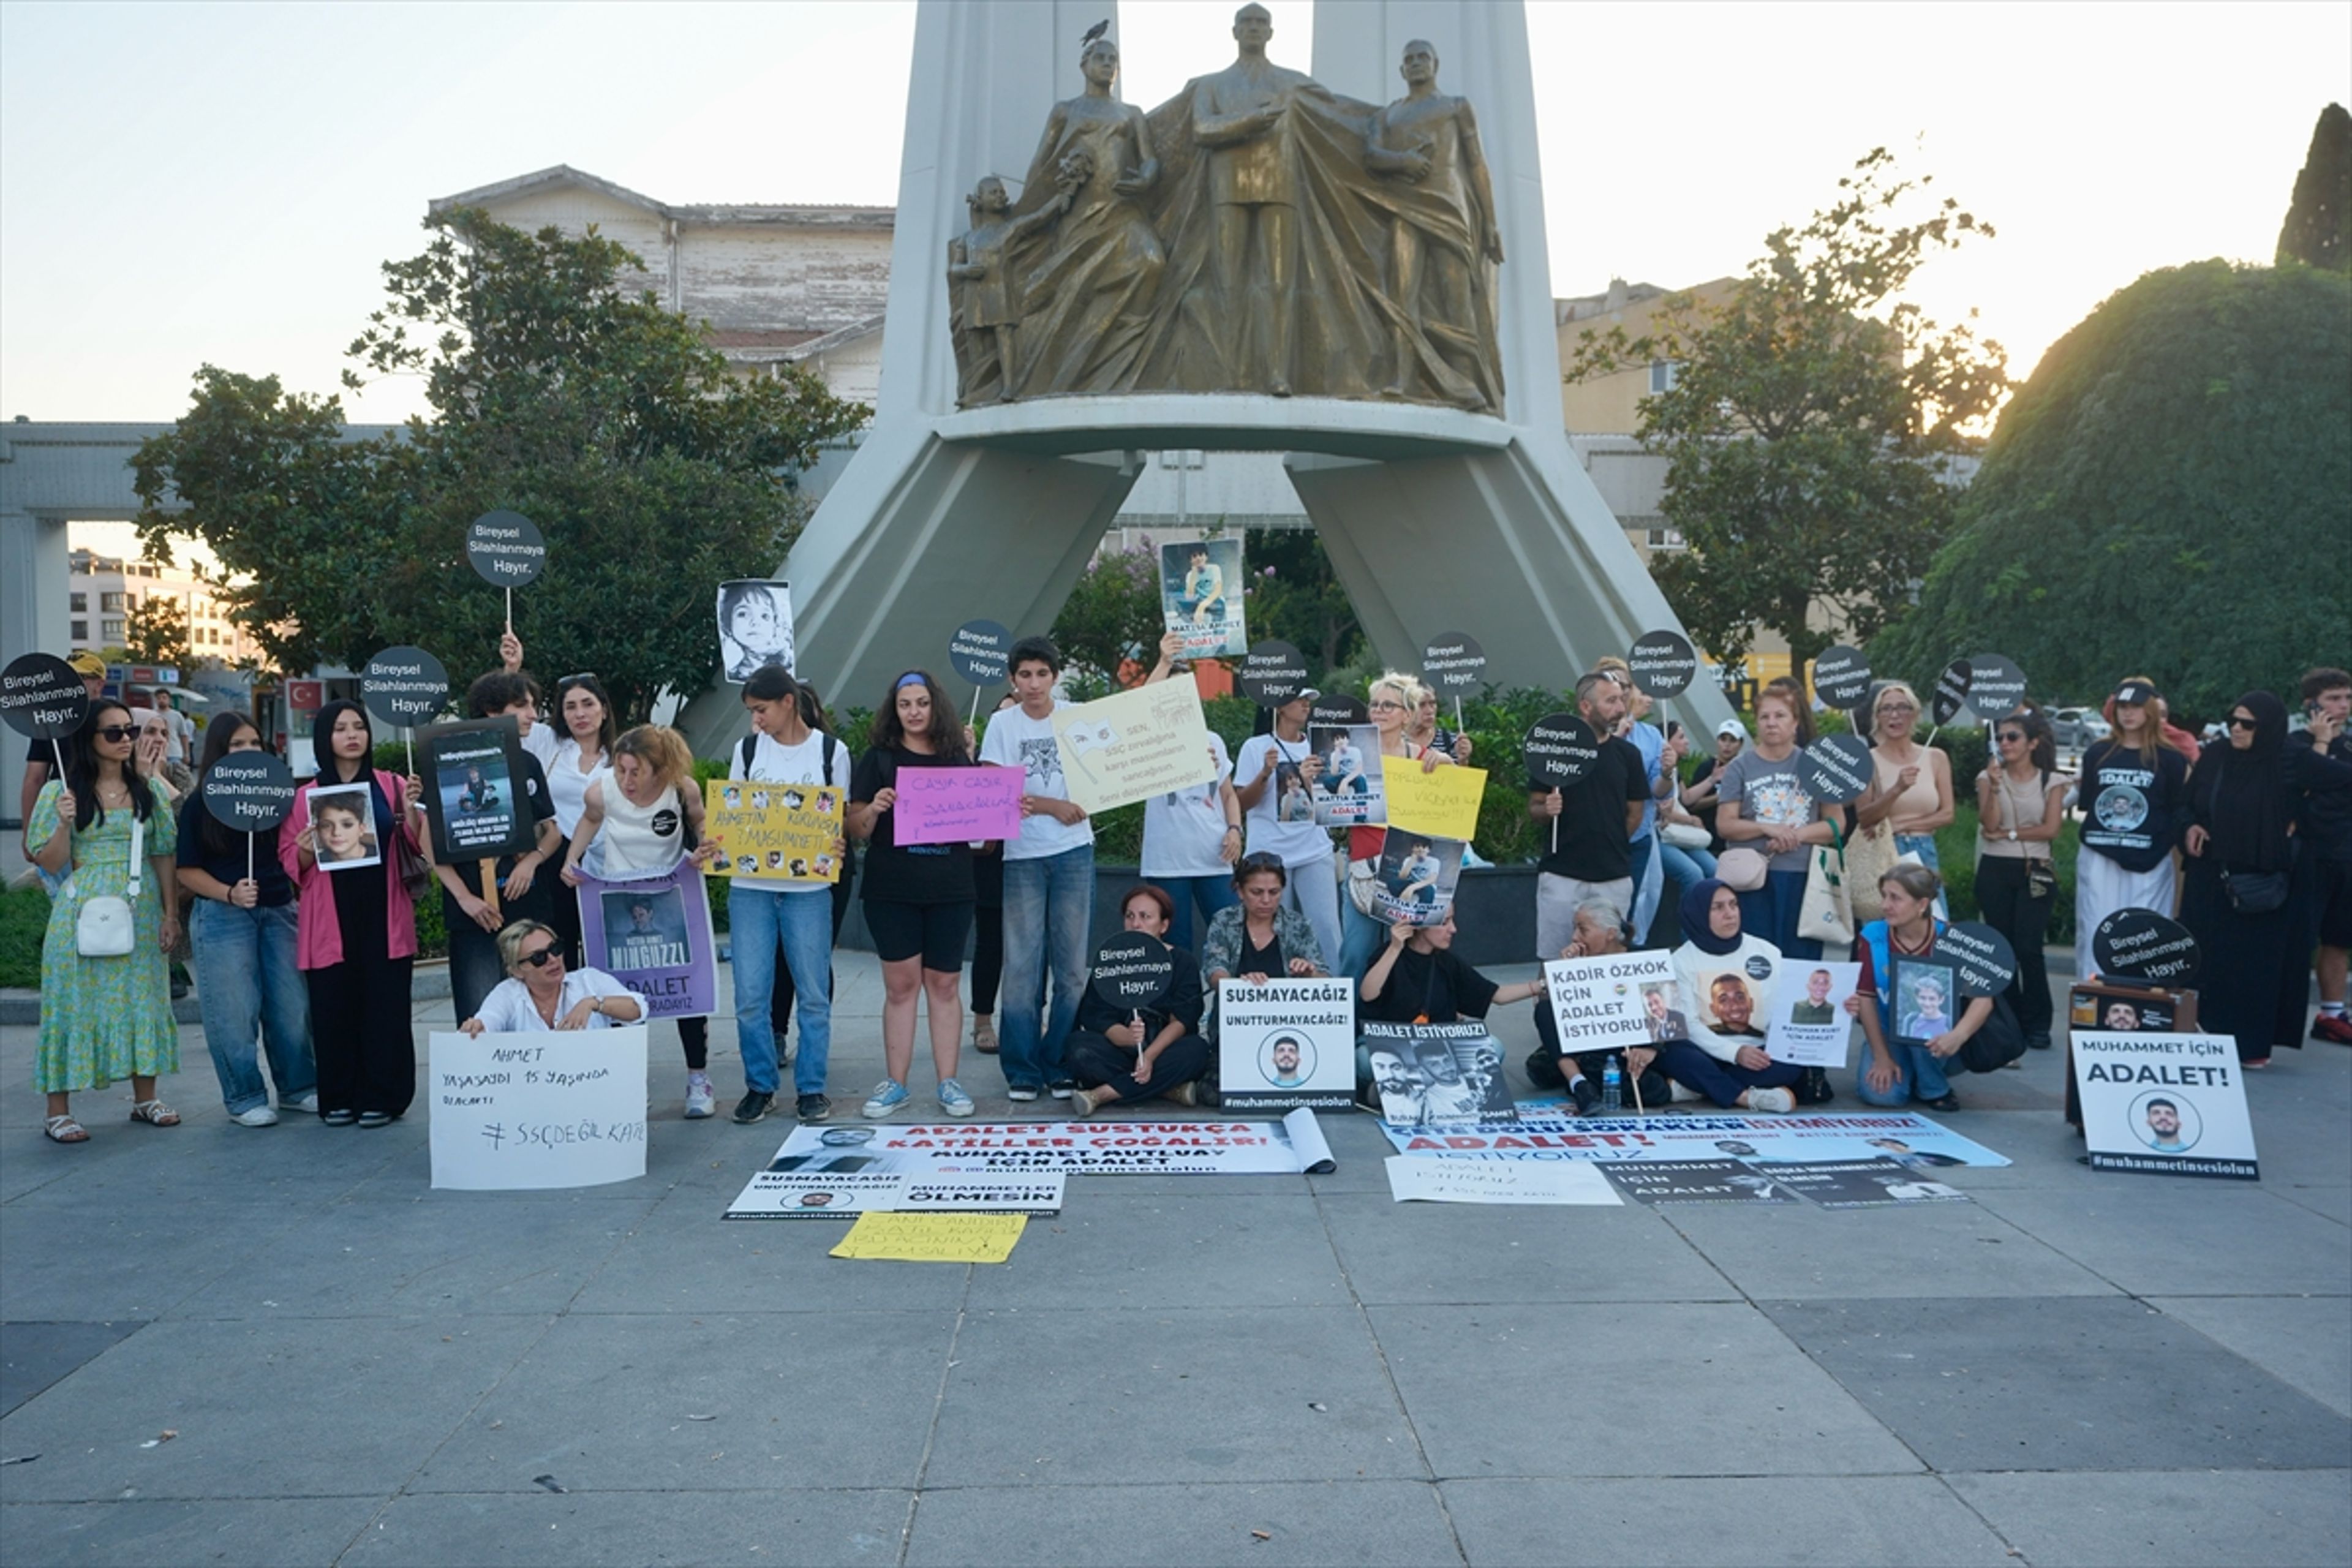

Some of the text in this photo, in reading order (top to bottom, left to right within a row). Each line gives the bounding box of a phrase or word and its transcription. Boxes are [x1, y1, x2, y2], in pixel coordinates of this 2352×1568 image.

[475, 525, 519, 538] Bireysel
[470, 541, 544, 556] Silahlanmaya
[494, 560, 532, 576] Hayır.
[959, 629, 998, 645] Bireysel
[1427, 644, 1464, 657] Bireysel
[1635, 644, 1673, 657] Bireysel
[1248, 655, 1286, 666] Bireysel
[1423, 657, 1485, 671] Silahlanmaya
[1630, 658, 1694, 671] Silahlanmaya
[1817, 658, 1852, 674] Bireysel
[372, 664, 420, 676] Bireysel
[970, 661, 1002, 677] Hayır.
[1242, 669, 1306, 679] Silahlanmaya
[4, 671, 55, 689] Bireysel
[364, 680, 448, 693] Silahlanmaya
[1444, 673, 1476, 686] Hayır.
[1651, 675, 1684, 688] Hayır.
[1, 686, 85, 708] Silahlanmaya
[1263, 684, 1295, 696] Hayır.
[1836, 685, 1864, 699] Hayır.
[391, 698, 434, 714] Hayır.
[1979, 696, 2013, 709] Hayır.
[34, 708, 78, 725] Hayır.
[1313, 707, 1351, 719] Bireysel
[1534, 727, 1577, 741] Bireysel
[1526, 742, 1597, 759] Silahlanmaya
[1820, 736, 1860, 767] Bireysel
[215, 767, 267, 780] Bireysel
[1546, 761, 1581, 776] Hayır.
[1804, 745, 1867, 792] Silahlanmaya
[206, 783, 295, 797] Silahlanmaya
[1812, 771, 1842, 798] Hayır.
[235, 802, 279, 816] Hayır.
[1948, 927, 1995, 954] Bireysel
[2109, 927, 2158, 950] Bireysel
[612, 942, 685, 970] MINGUZZI
[1101, 946, 1145, 961] Bireysel
[1935, 939, 2013, 980] Silahlanmaya
[2111, 937, 2194, 967] Silahlanmaya
[1095, 962, 1171, 979] Silahlanmaya
[1553, 966, 1605, 984] KADİR
[2144, 959, 2190, 979] Hayır.
[626, 976, 690, 997] DALET
[1120, 981, 1158, 995] Hayır.
[1226, 984, 1347, 1002] SUSMAYACAĞIZ
[1556, 987, 1591, 1003] İÇİN
[1562, 1001, 1624, 1020] ADALET
[1226, 1012, 1348, 1026] UNUTTURMAYACAĞIZ!
[1364, 1023, 1411, 1038] ADALET
[492, 1047, 545, 1063] AHMET
[2082, 1041, 2224, 1056] MUHAMMET İÇİN
[2087, 1063, 2229, 1087] ADALET!
[1226, 1096, 1351, 1107] #muhammetinsesiolun
[906, 1125, 1251, 1135] ADALET SUSTUKÇA
[887, 1136, 1267, 1148] KATİLLER ÇOĞALIR!
[1407, 1133, 1656, 1150] ADALET!
[2093, 1156, 2255, 1175] #muhammetinsesiolun
[908, 1191, 1054, 1201] ÖLMESİN
[1636, 1186, 1733, 1194] ADALET
